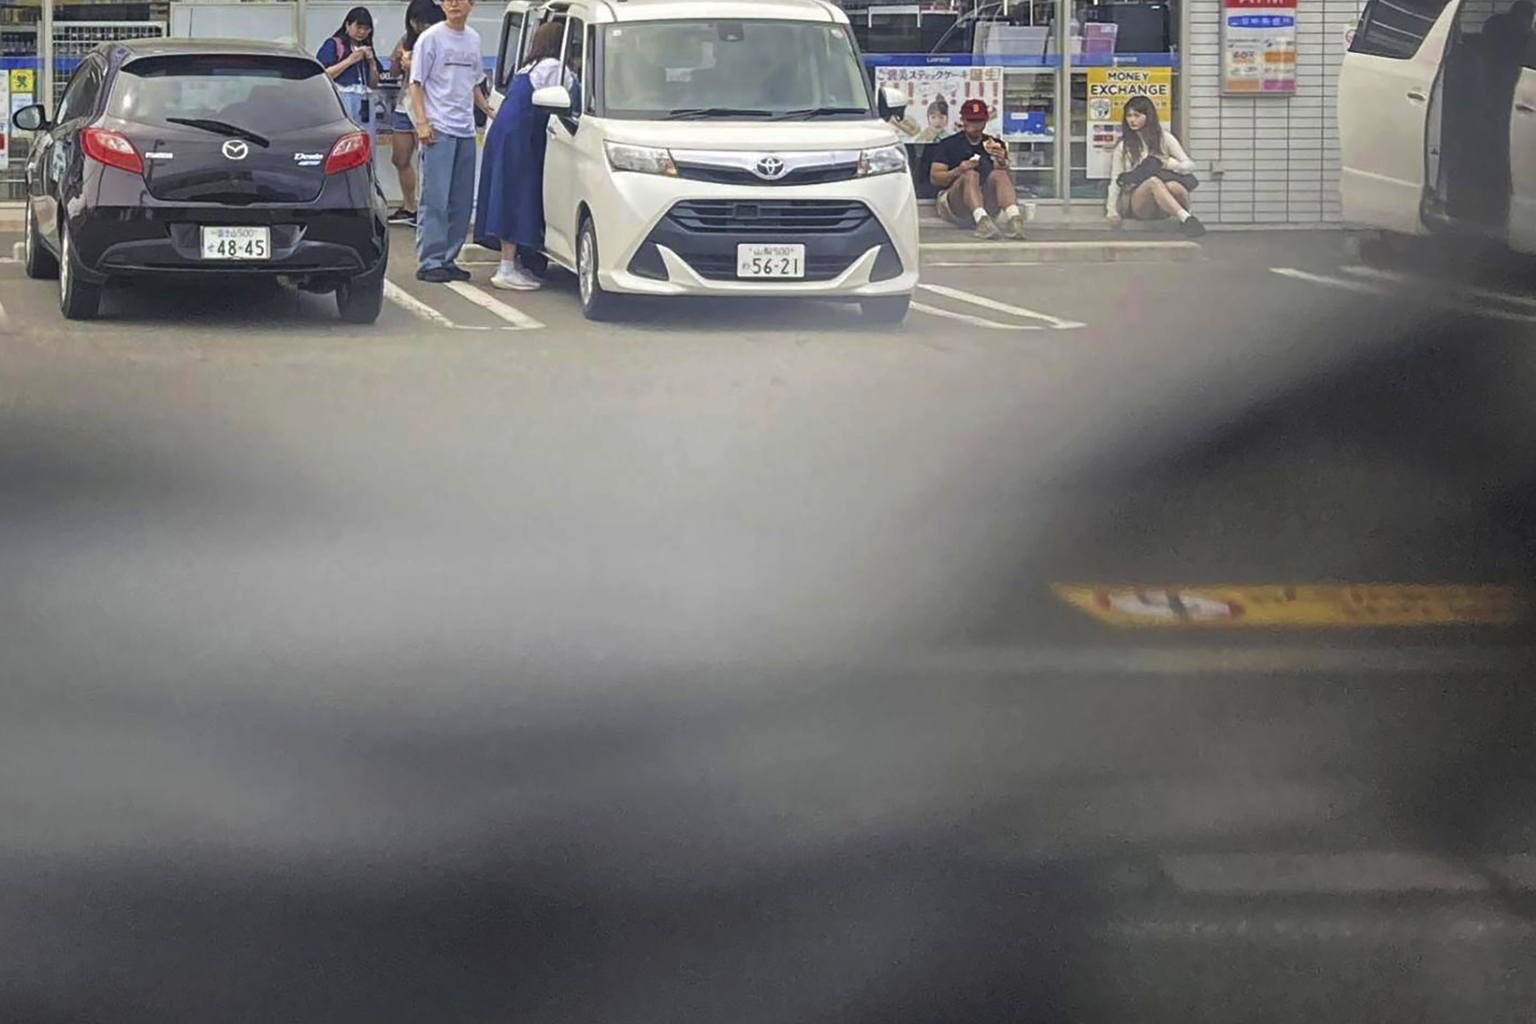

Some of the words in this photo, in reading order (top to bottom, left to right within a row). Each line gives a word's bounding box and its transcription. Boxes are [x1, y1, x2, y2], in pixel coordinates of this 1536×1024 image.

[1108, 72, 1149, 81] MONEY
[1090, 84, 1167, 95] EXCHANGE
[217, 239, 265, 256] 48-45
[752, 258, 798, 275] 56-21
